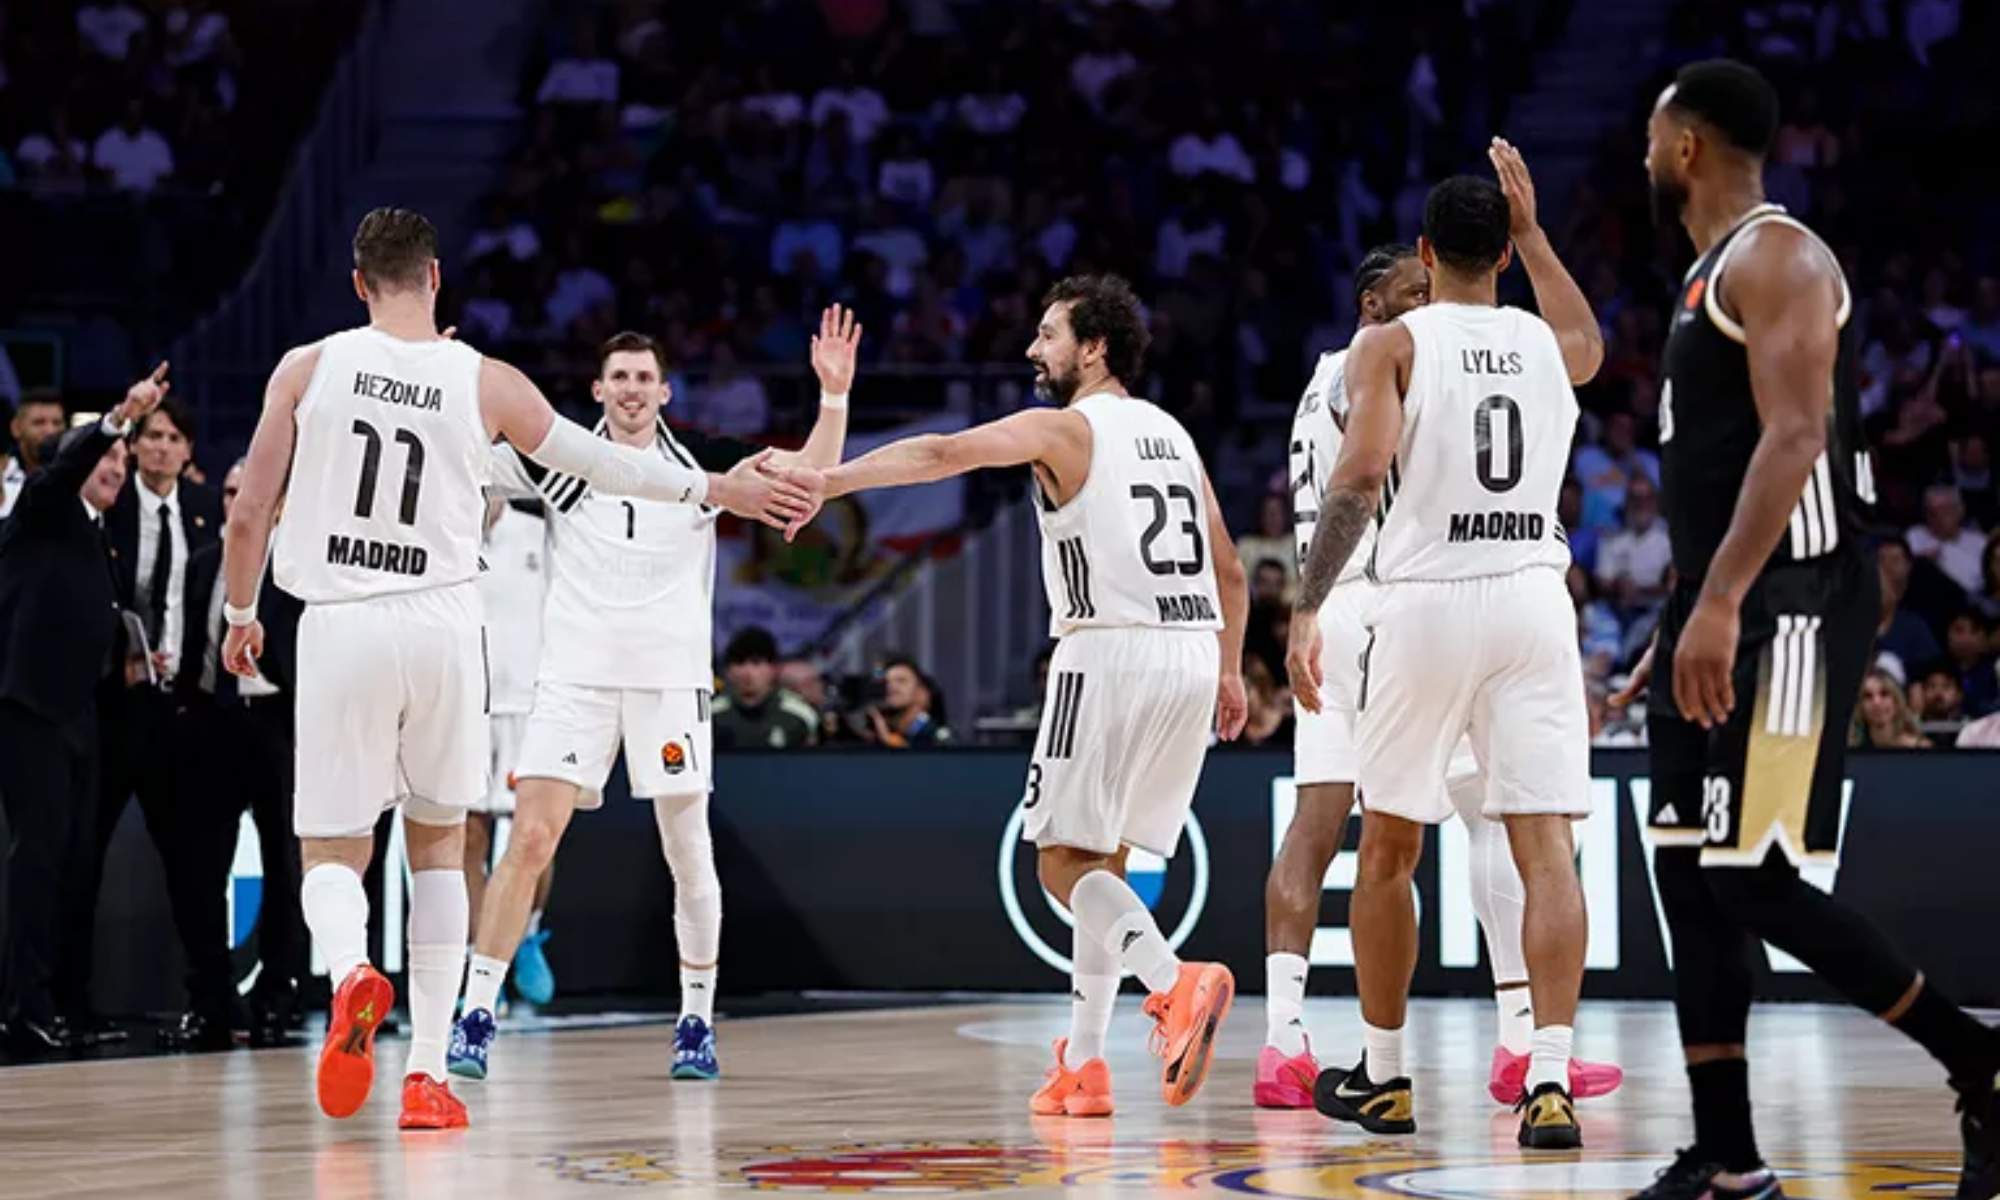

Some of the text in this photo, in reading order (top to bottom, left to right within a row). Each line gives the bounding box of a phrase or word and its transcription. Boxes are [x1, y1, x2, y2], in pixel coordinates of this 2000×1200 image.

[1462, 349, 1523, 374] LYLES
[353, 371, 441, 411] HEZONJA
[1474, 394, 1524, 494] 0
[352, 419, 424, 525] 11
[621, 500, 634, 539] 1
[1130, 484, 1203, 575] 23
[1449, 511, 1545, 543] MADRID
[327, 535, 427, 576] MADRID
